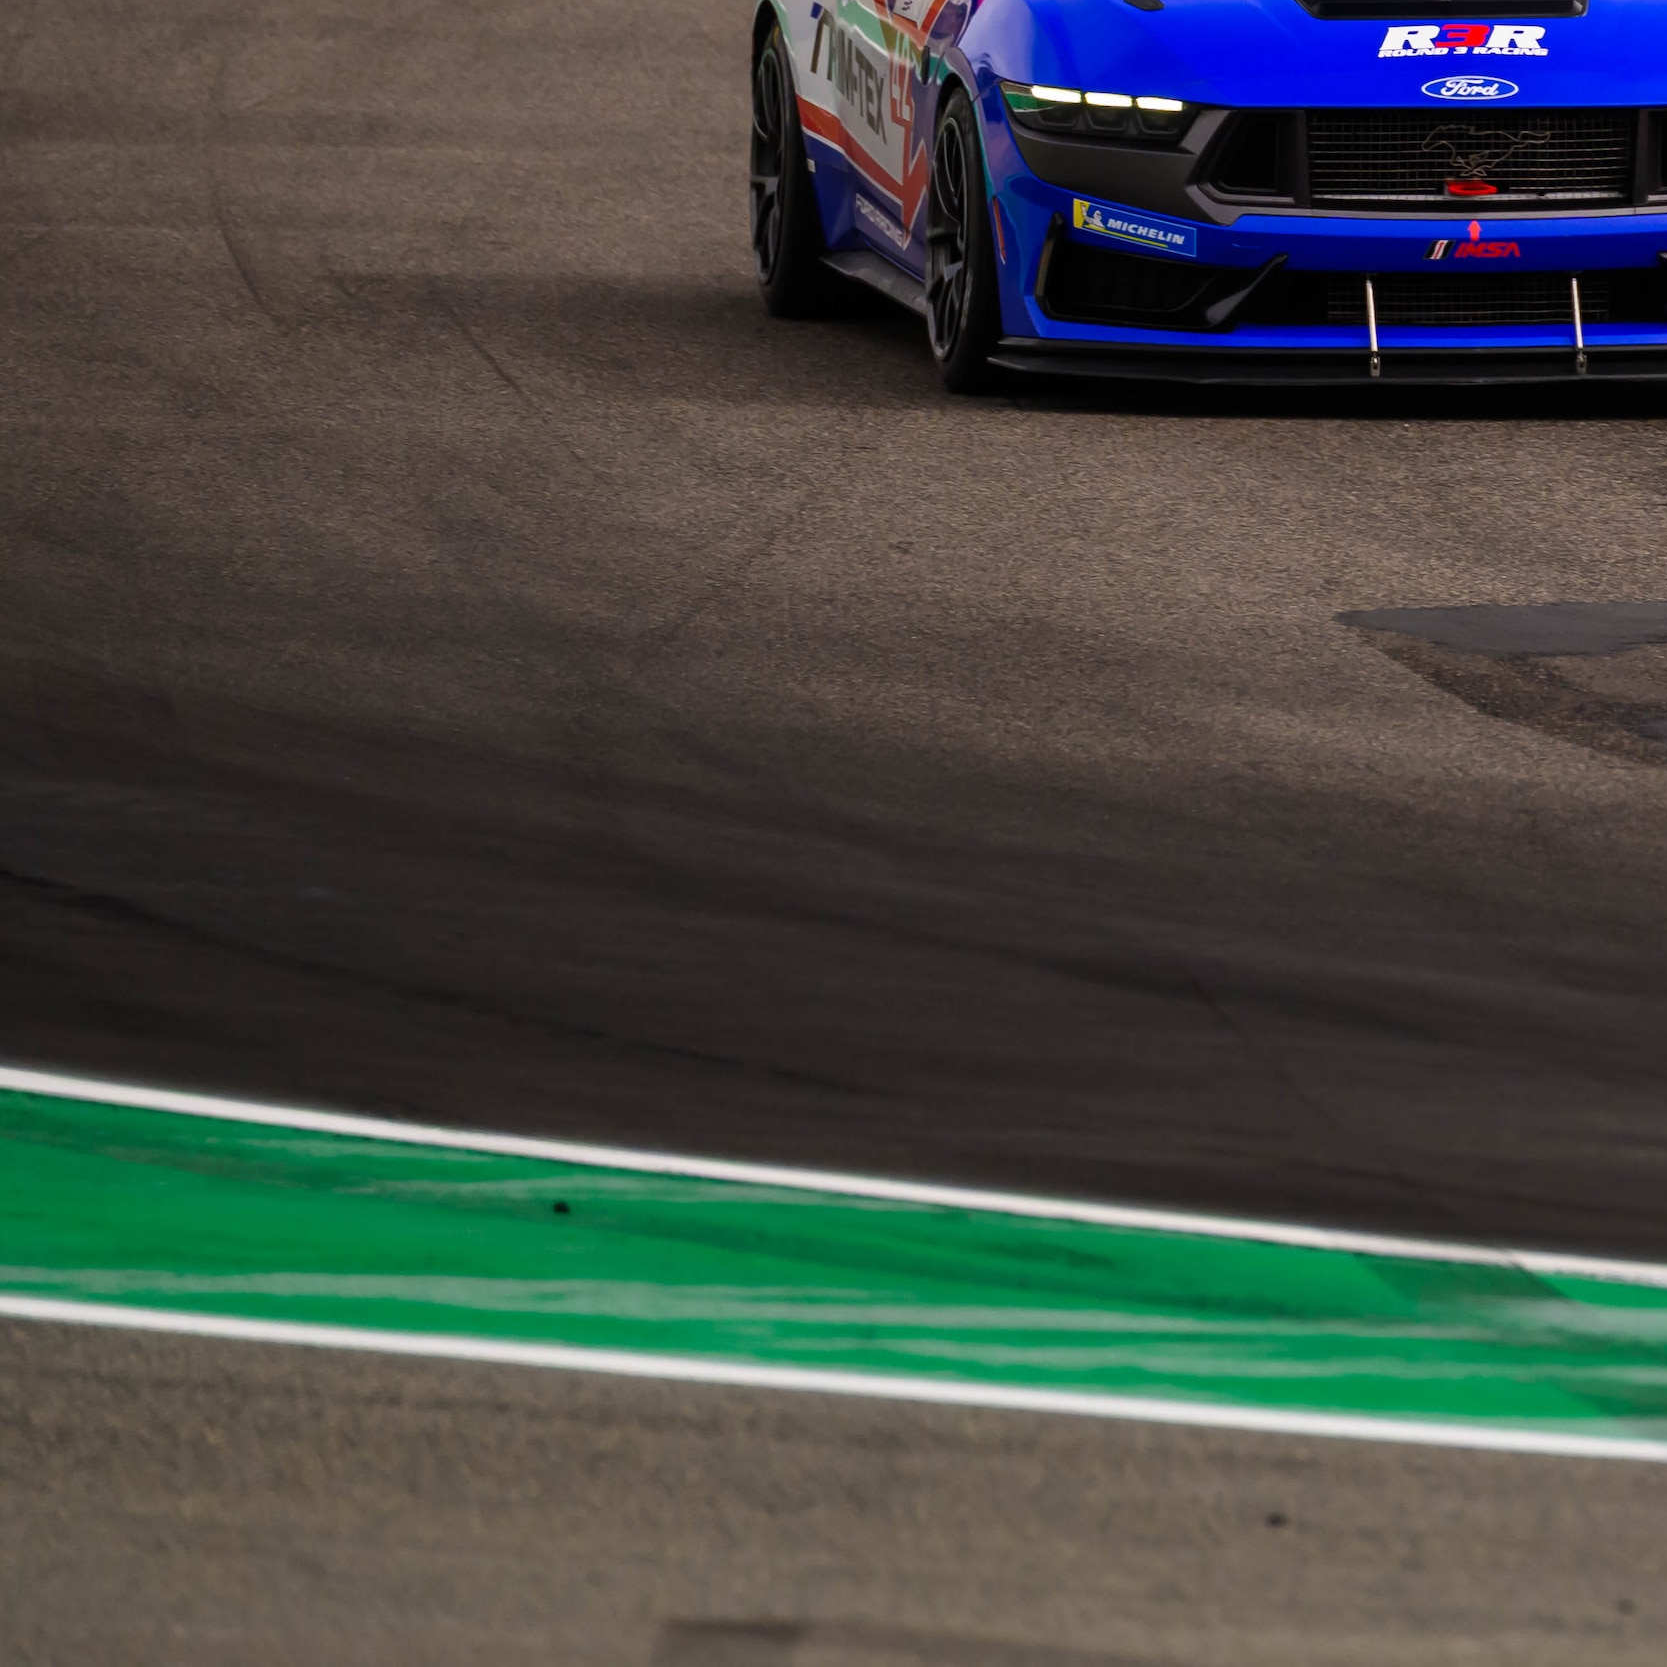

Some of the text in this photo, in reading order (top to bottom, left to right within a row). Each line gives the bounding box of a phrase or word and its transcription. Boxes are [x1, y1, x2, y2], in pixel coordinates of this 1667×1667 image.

[1380, 24, 1546, 50] R3R
[1378, 46, 1549, 58] ROUND 3 RACING
[1107, 218, 1186, 245] MICHELIN
[1454, 241, 1521, 258] IMSA
